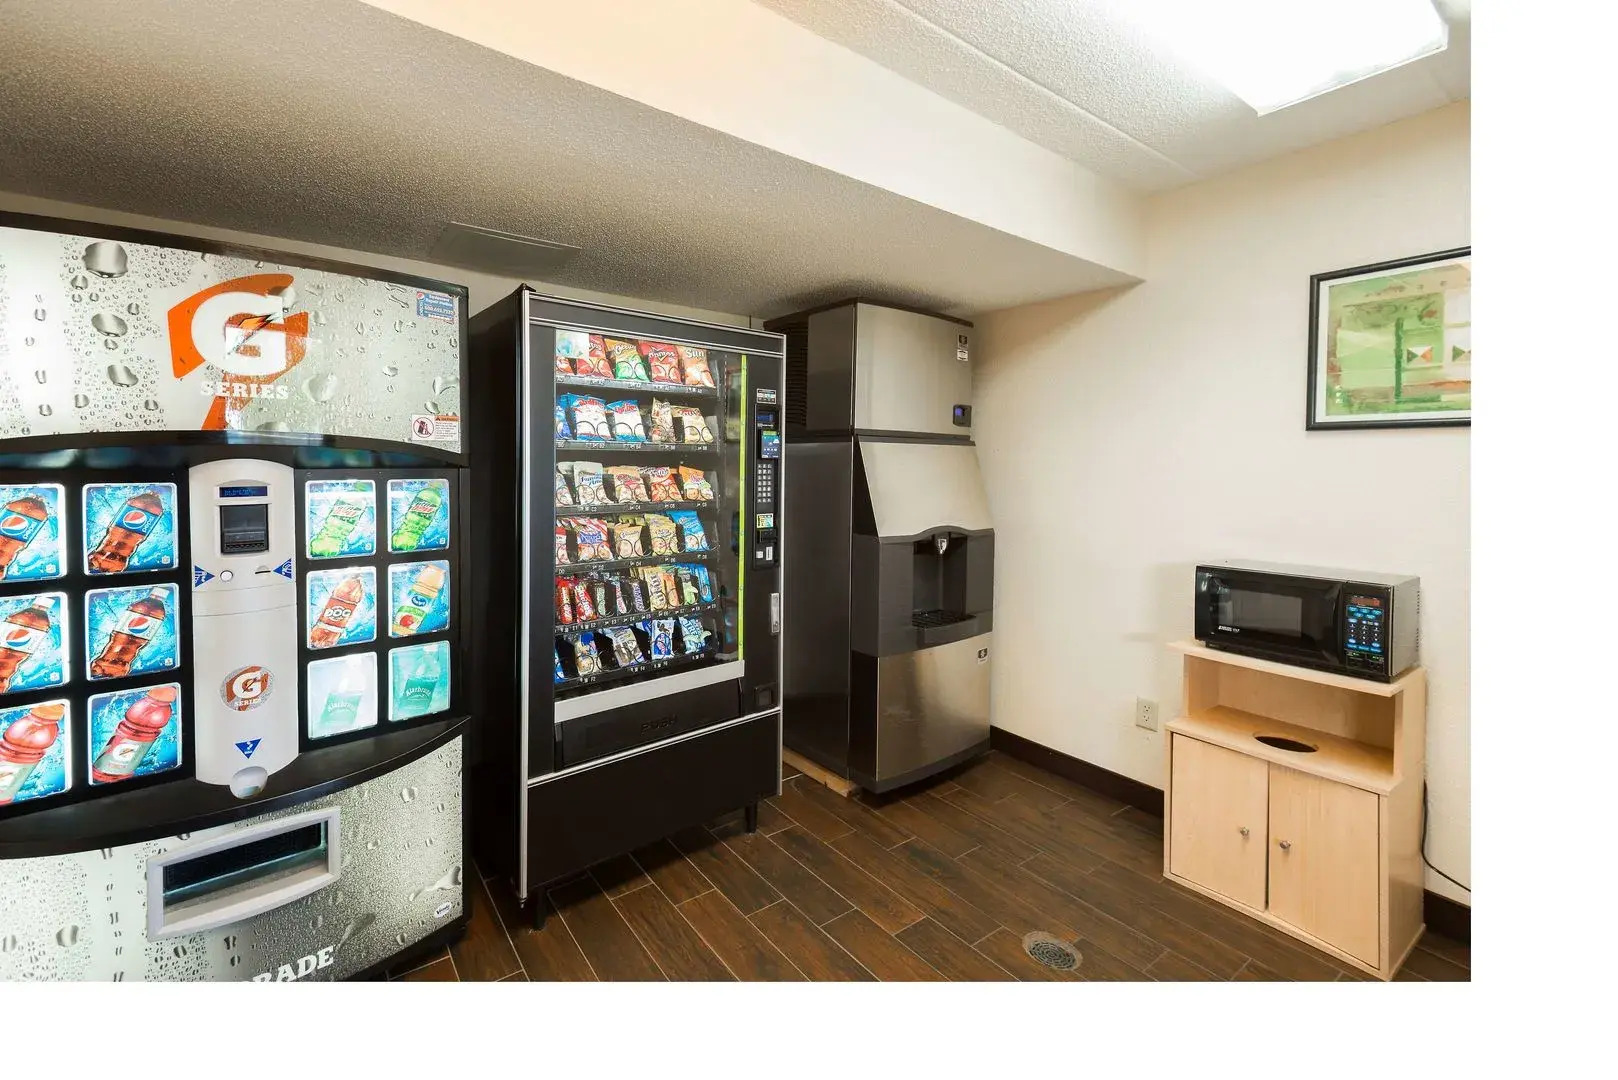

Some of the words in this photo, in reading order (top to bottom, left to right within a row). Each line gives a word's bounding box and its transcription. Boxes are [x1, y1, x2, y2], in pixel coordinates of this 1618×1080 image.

[191, 291, 287, 376] G
[200, 381, 288, 399] SERIES
[232, 671, 261, 699] G
